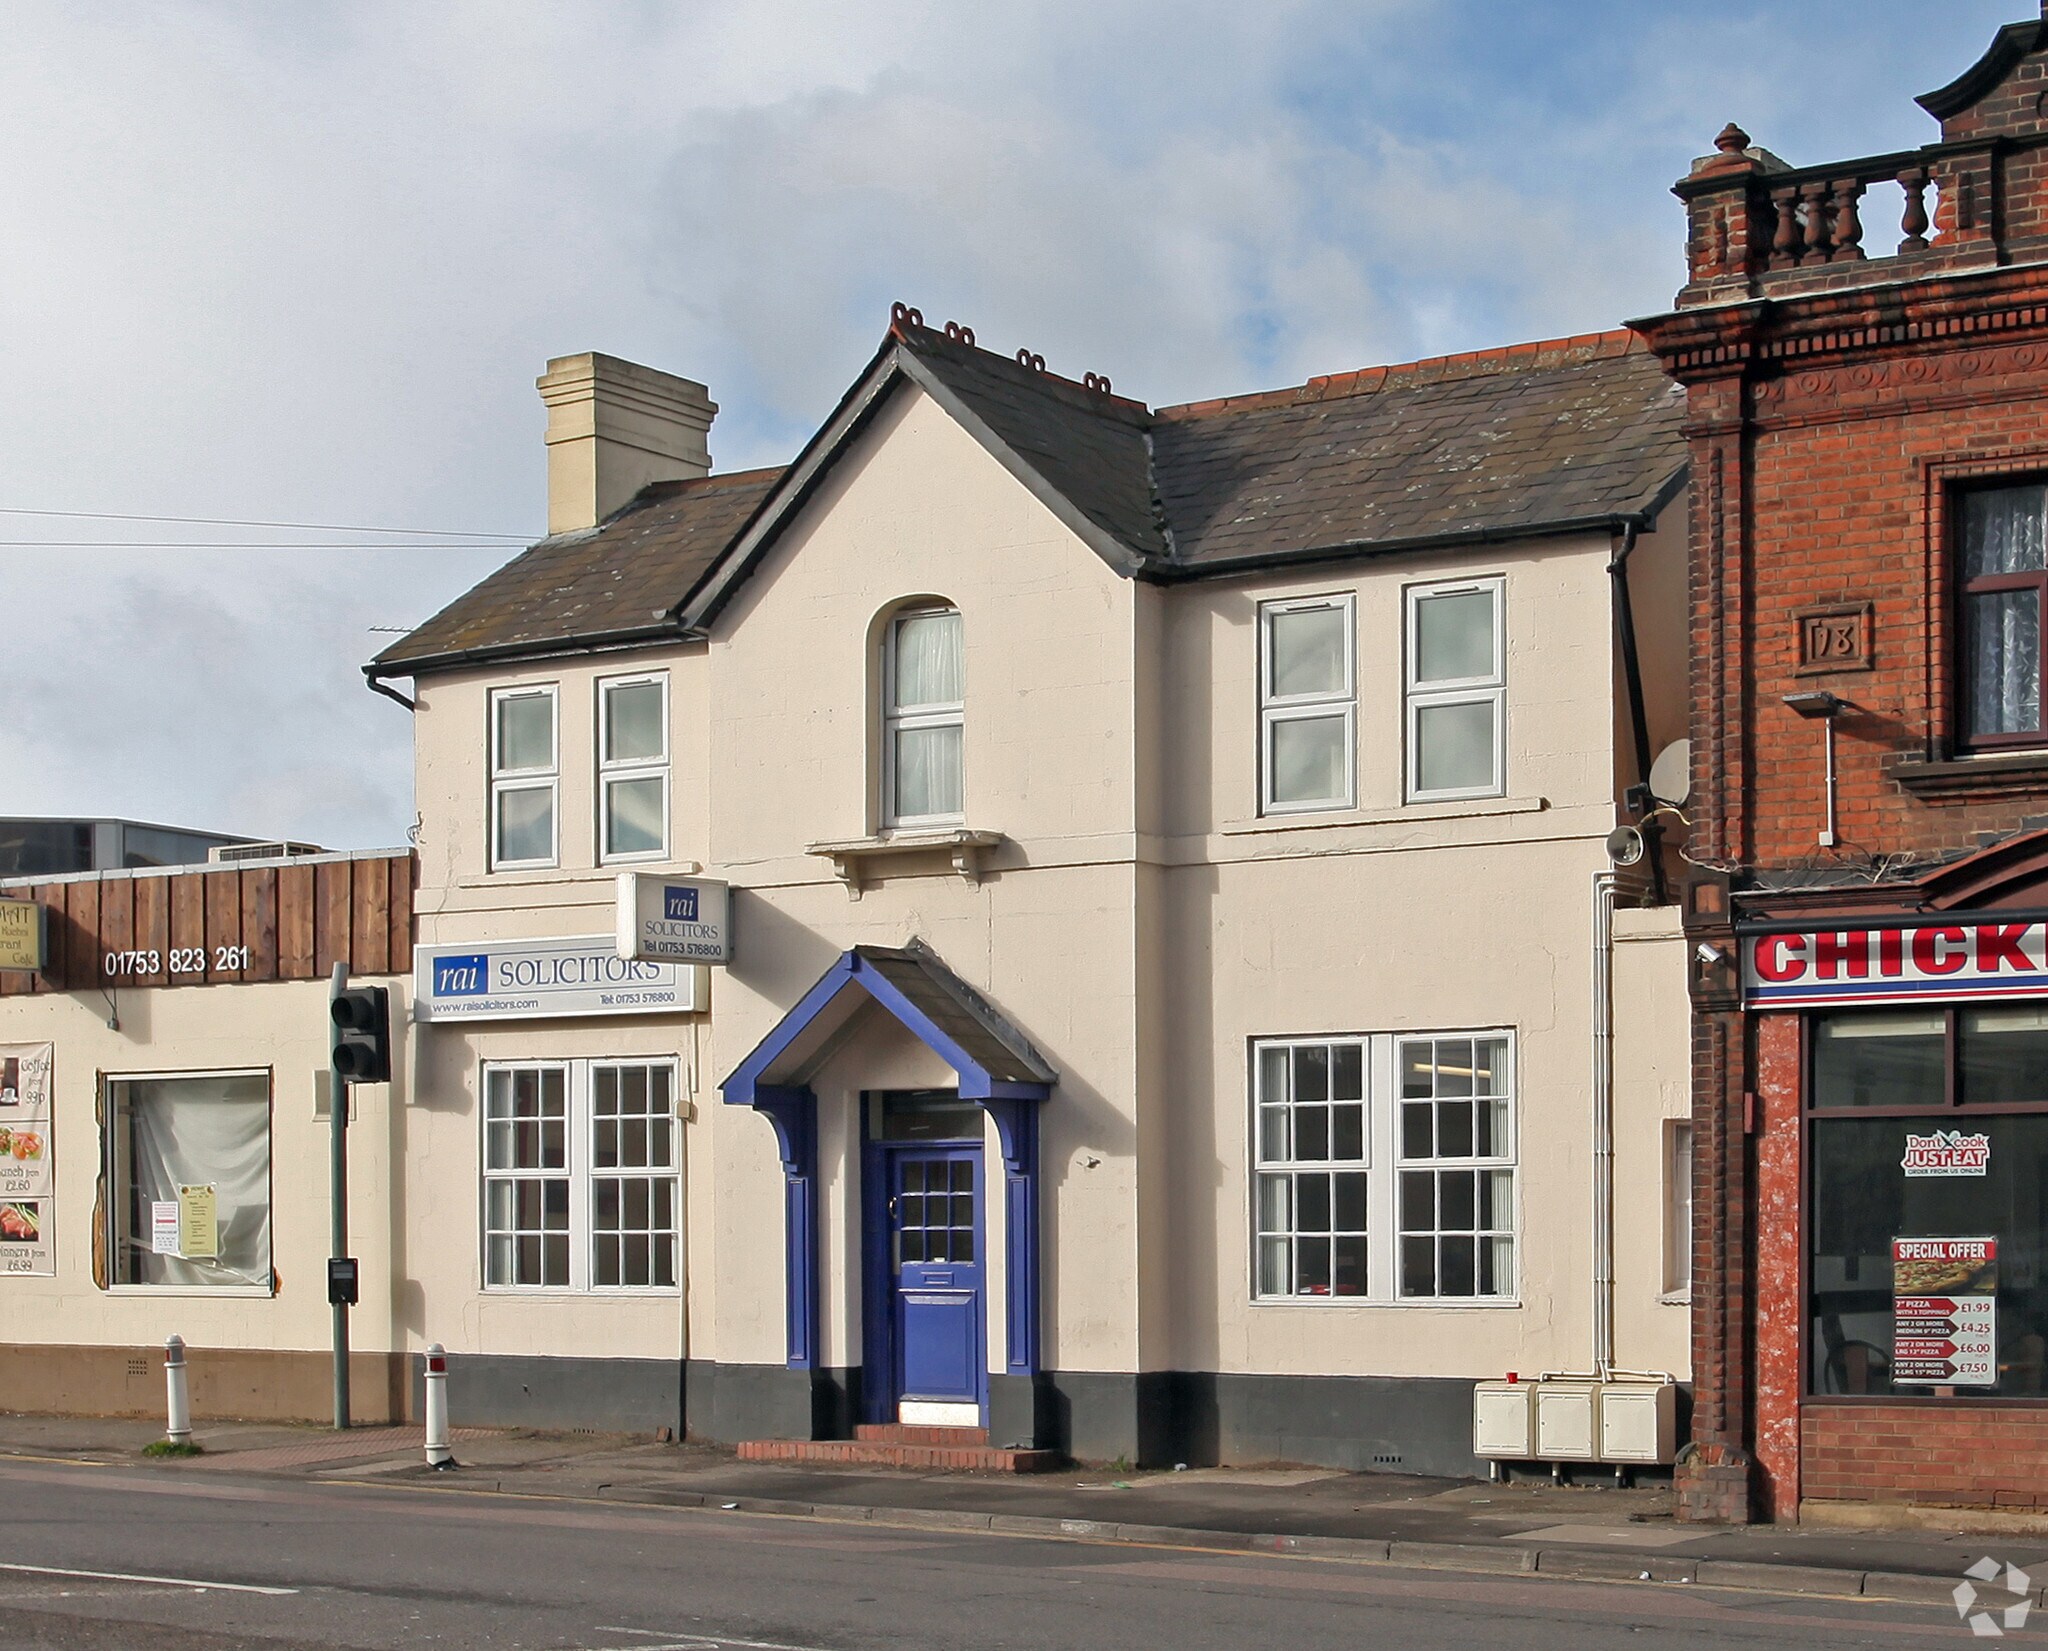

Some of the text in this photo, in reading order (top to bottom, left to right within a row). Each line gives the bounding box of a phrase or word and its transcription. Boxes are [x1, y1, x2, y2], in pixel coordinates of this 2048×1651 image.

[669, 892, 695, 917] rai
[645, 920, 719, 940] SOLICITORS
[643, 940, 722, 957] Tel 01753 576800
[1753, 923, 2048, 983] CHICK
[105, 945, 248, 976] 01753 823 261
[439, 955, 662, 992] rai SOLICITORS
[433, 999, 539, 1013] www.raisolicitors.com
[616, 993, 640, 1004] 01753
[642, 991, 676, 1003] 576800
[26, 1090, 46, 1105] 99p
[1953, 1135, 1986, 1147] cook
[1904, 1149, 1987, 1167] JUST EAT
[0, 1165, 24, 1178] unch
[1899, 1242, 1986, 1259] SPECIAL OFFER
[1906, 1300, 1931, 1308] PIZZA
[1961, 1302, 1990, 1313] £1.99
[1961, 1322, 1990, 1334] £4.25
[1960, 1343, 1990, 1353] £6.00
[1959, 1362, 1988, 1373] £7.50
